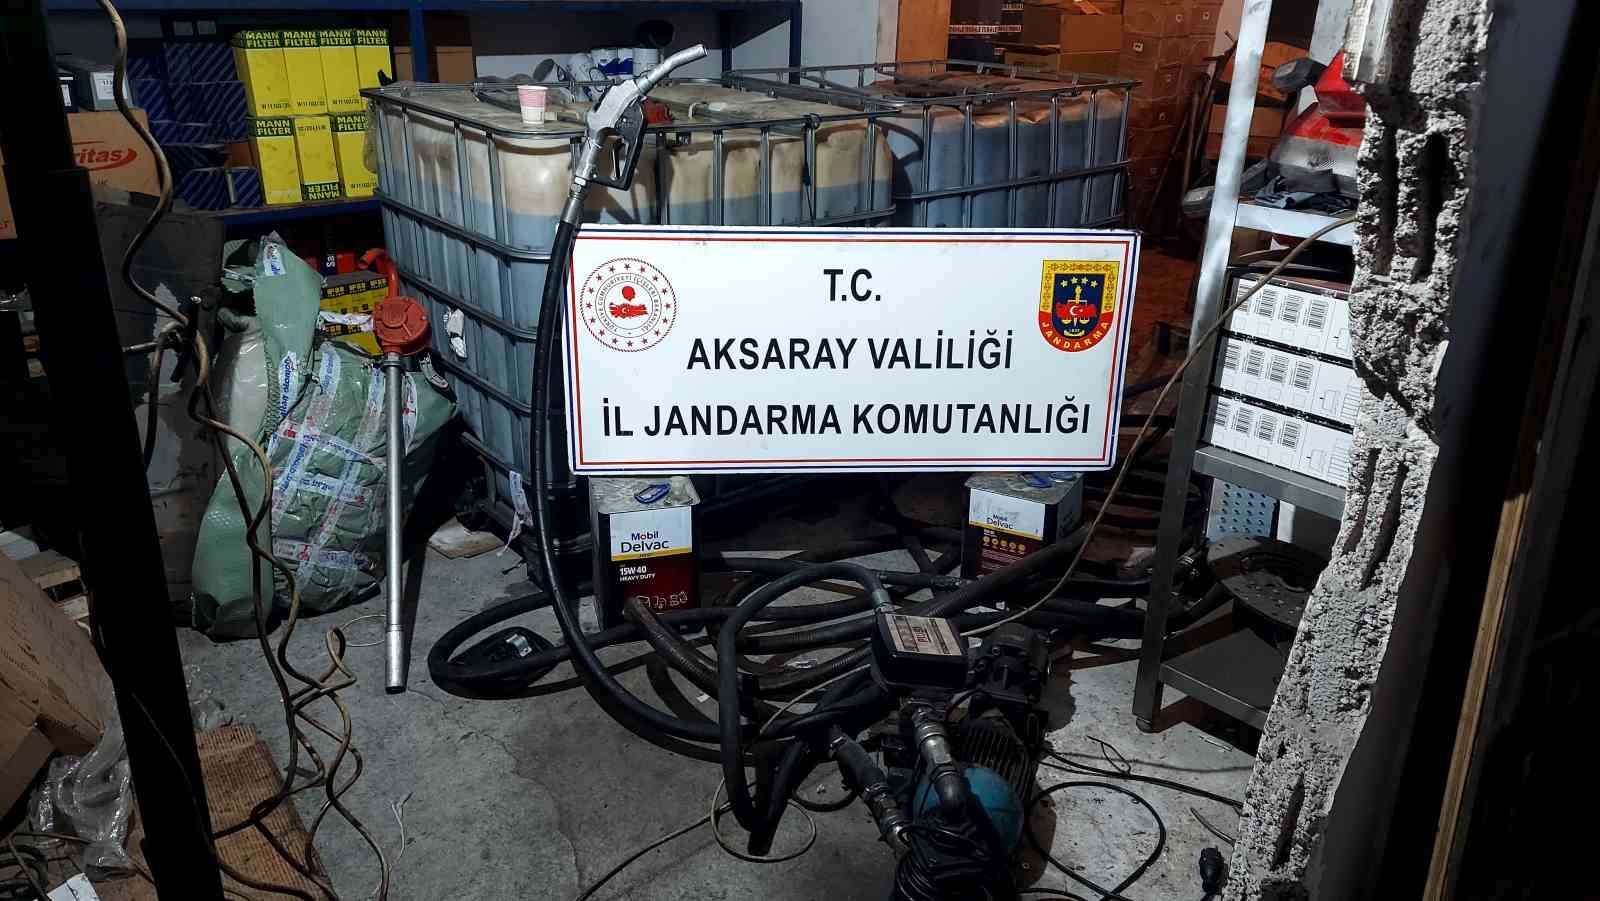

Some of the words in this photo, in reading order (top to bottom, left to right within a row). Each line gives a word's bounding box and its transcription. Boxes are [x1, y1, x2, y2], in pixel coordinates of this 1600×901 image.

[245, 31, 279, 40] MANN
[284, 31, 316, 39] MANN
[320, 30, 351, 38] MANN
[357, 30, 386, 38] MANN
[246, 39, 281, 48] FILTER
[284, 38, 317, 47] FILTER
[320, 37, 351, 45] FILTER
[357, 37, 387, 45] FILTER
[337, 115, 368, 123] MANN
[256, 120, 290, 128] MANN
[338, 122, 369, 131] FILTER
[257, 127, 292, 135] FILTER
[307, 183, 339, 193] FILTER
[309, 191, 340, 200] MANN
[823, 268, 881, 302] T.C.
[1041, 321, 1110, 349] JANDARMA
[686, 337, 858, 370] AKSARAY
[868, 329, 1013, 370] VALİLİĞİ
[602, 397, 634, 437] İL
[644, 404, 841, 436] JANDARMA
[853, 395, 1091, 434] KOMUTANLIĞI
[986, 517, 1014, 529] Delvac
[631, 531, 659, 541] Mobil
[621, 541, 669, 553] Delvac
[619, 567, 636, 576] 15W
[636, 565, 647, 574] 40
